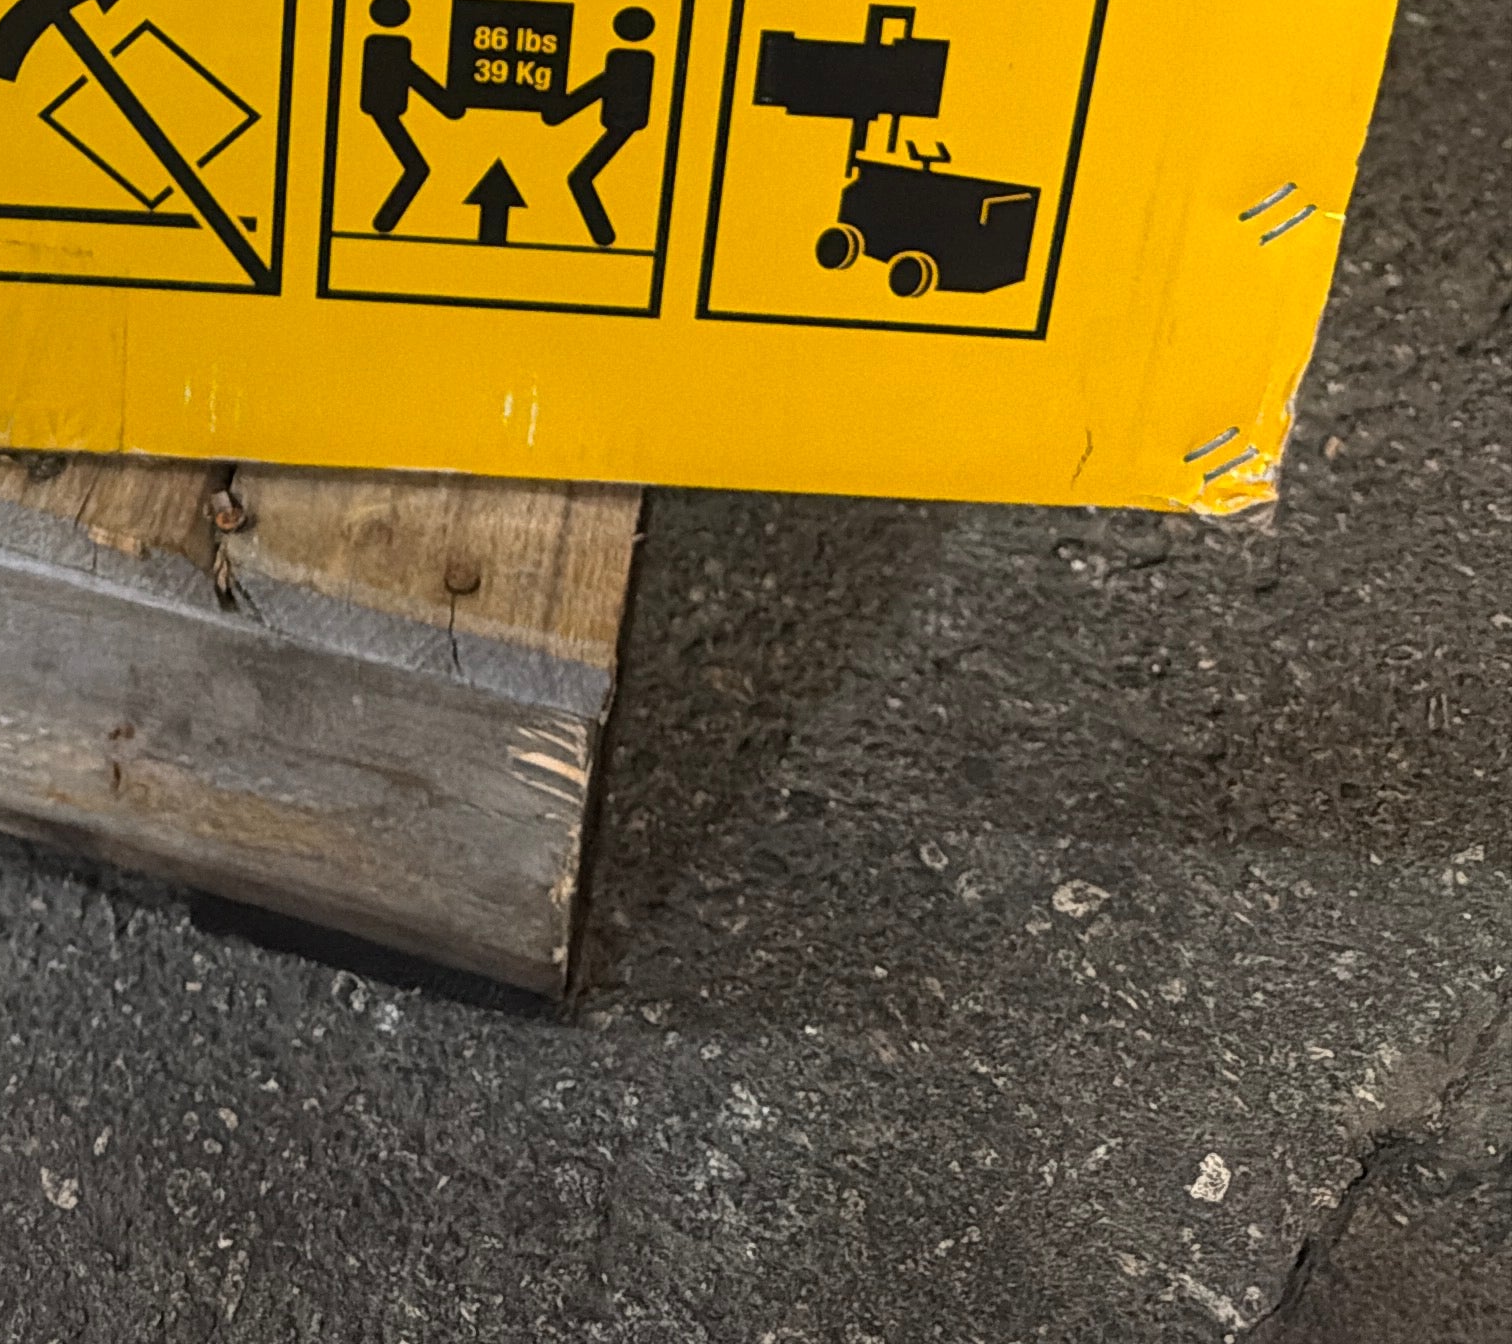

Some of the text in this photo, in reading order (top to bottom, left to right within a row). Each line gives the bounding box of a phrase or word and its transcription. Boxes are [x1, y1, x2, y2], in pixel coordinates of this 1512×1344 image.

[473, 25, 558, 54] 86 lbs
[473, 58, 552, 92] 39 Kg
